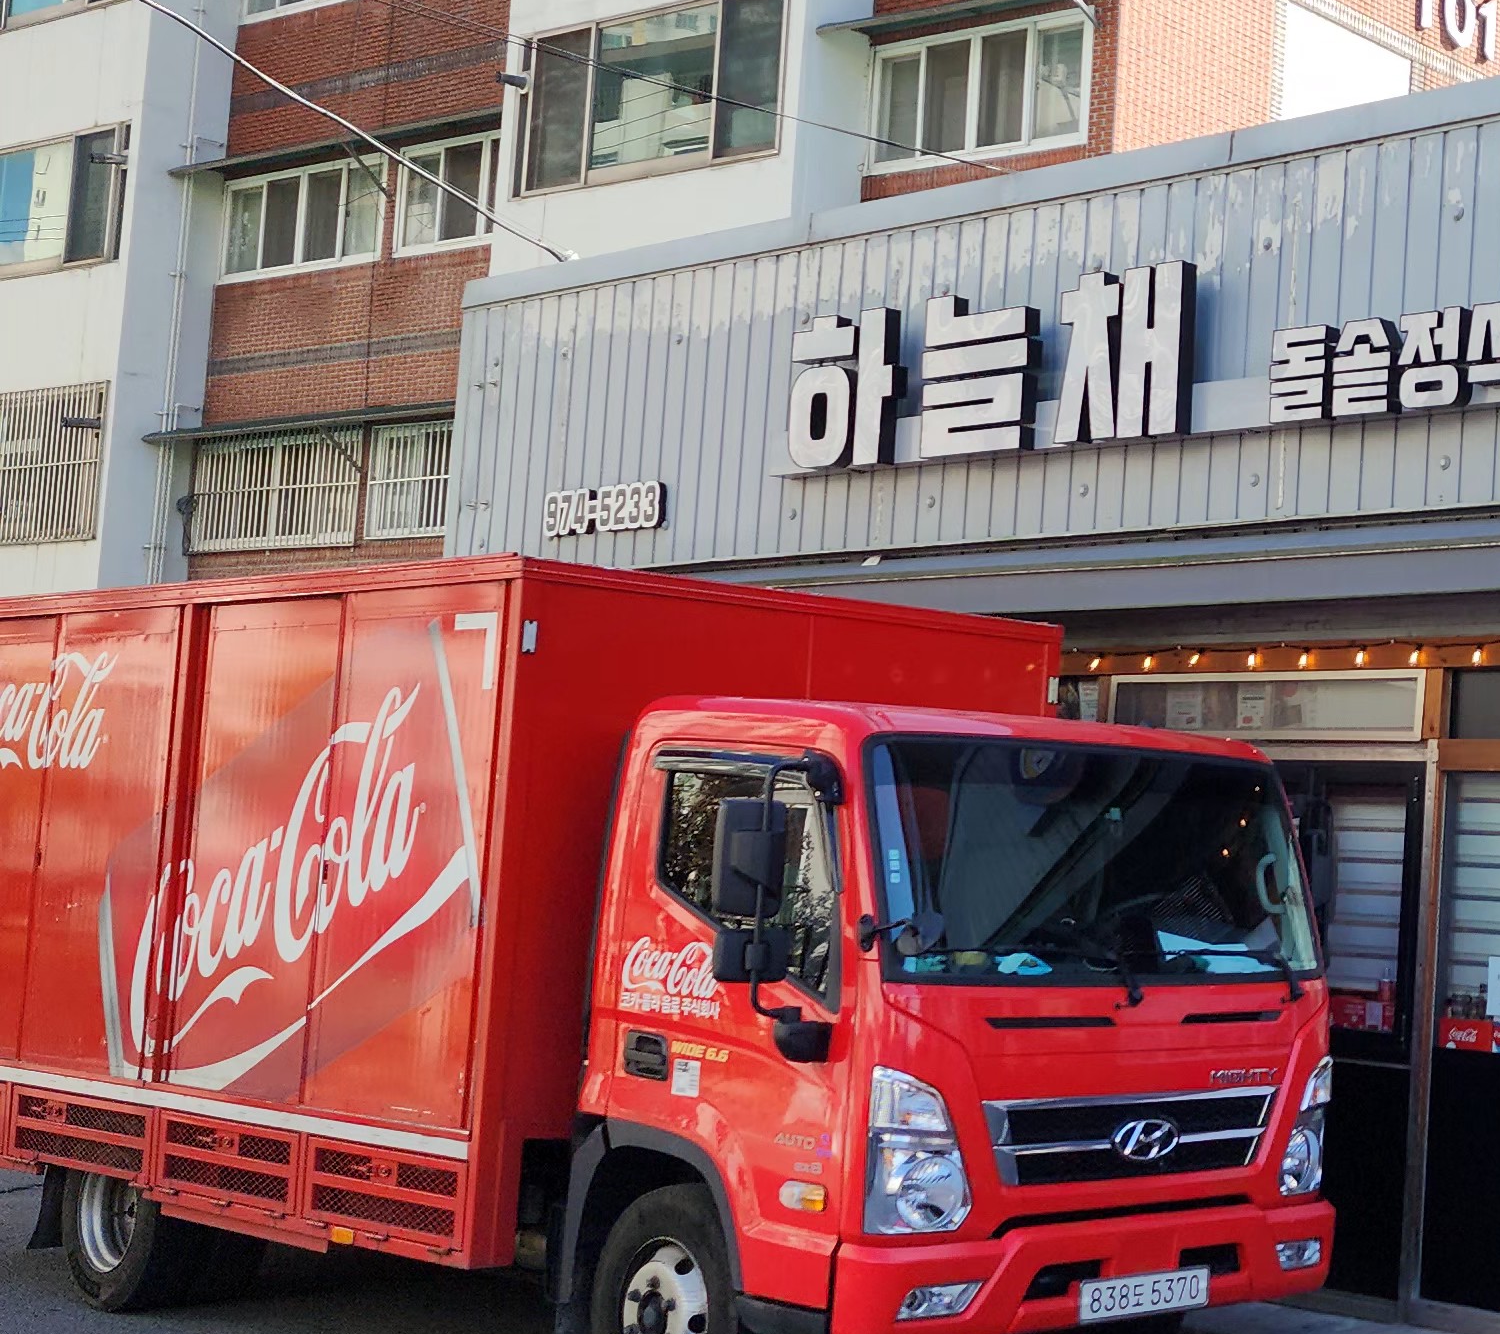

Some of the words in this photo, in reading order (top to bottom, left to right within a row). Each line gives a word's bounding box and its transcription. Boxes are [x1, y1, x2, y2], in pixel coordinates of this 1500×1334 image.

[788, 261, 1196, 468] 하늘채
[544, 480, 664, 538] 974-5233
[130, 682, 421, 1059] Coca-Cola
[621, 936, 718, 999] Coca-Cola
[671, 1040, 706, 1059] WIDE
[705, 1047, 730, 1063] 6.6
[1209, 1067, 1278, 1085] MIGHTY
[773, 1132, 816, 1151] AUTO
[1090, 1283, 1144, 1315] 838도
[1150, 1273, 1200, 1306] 5370
